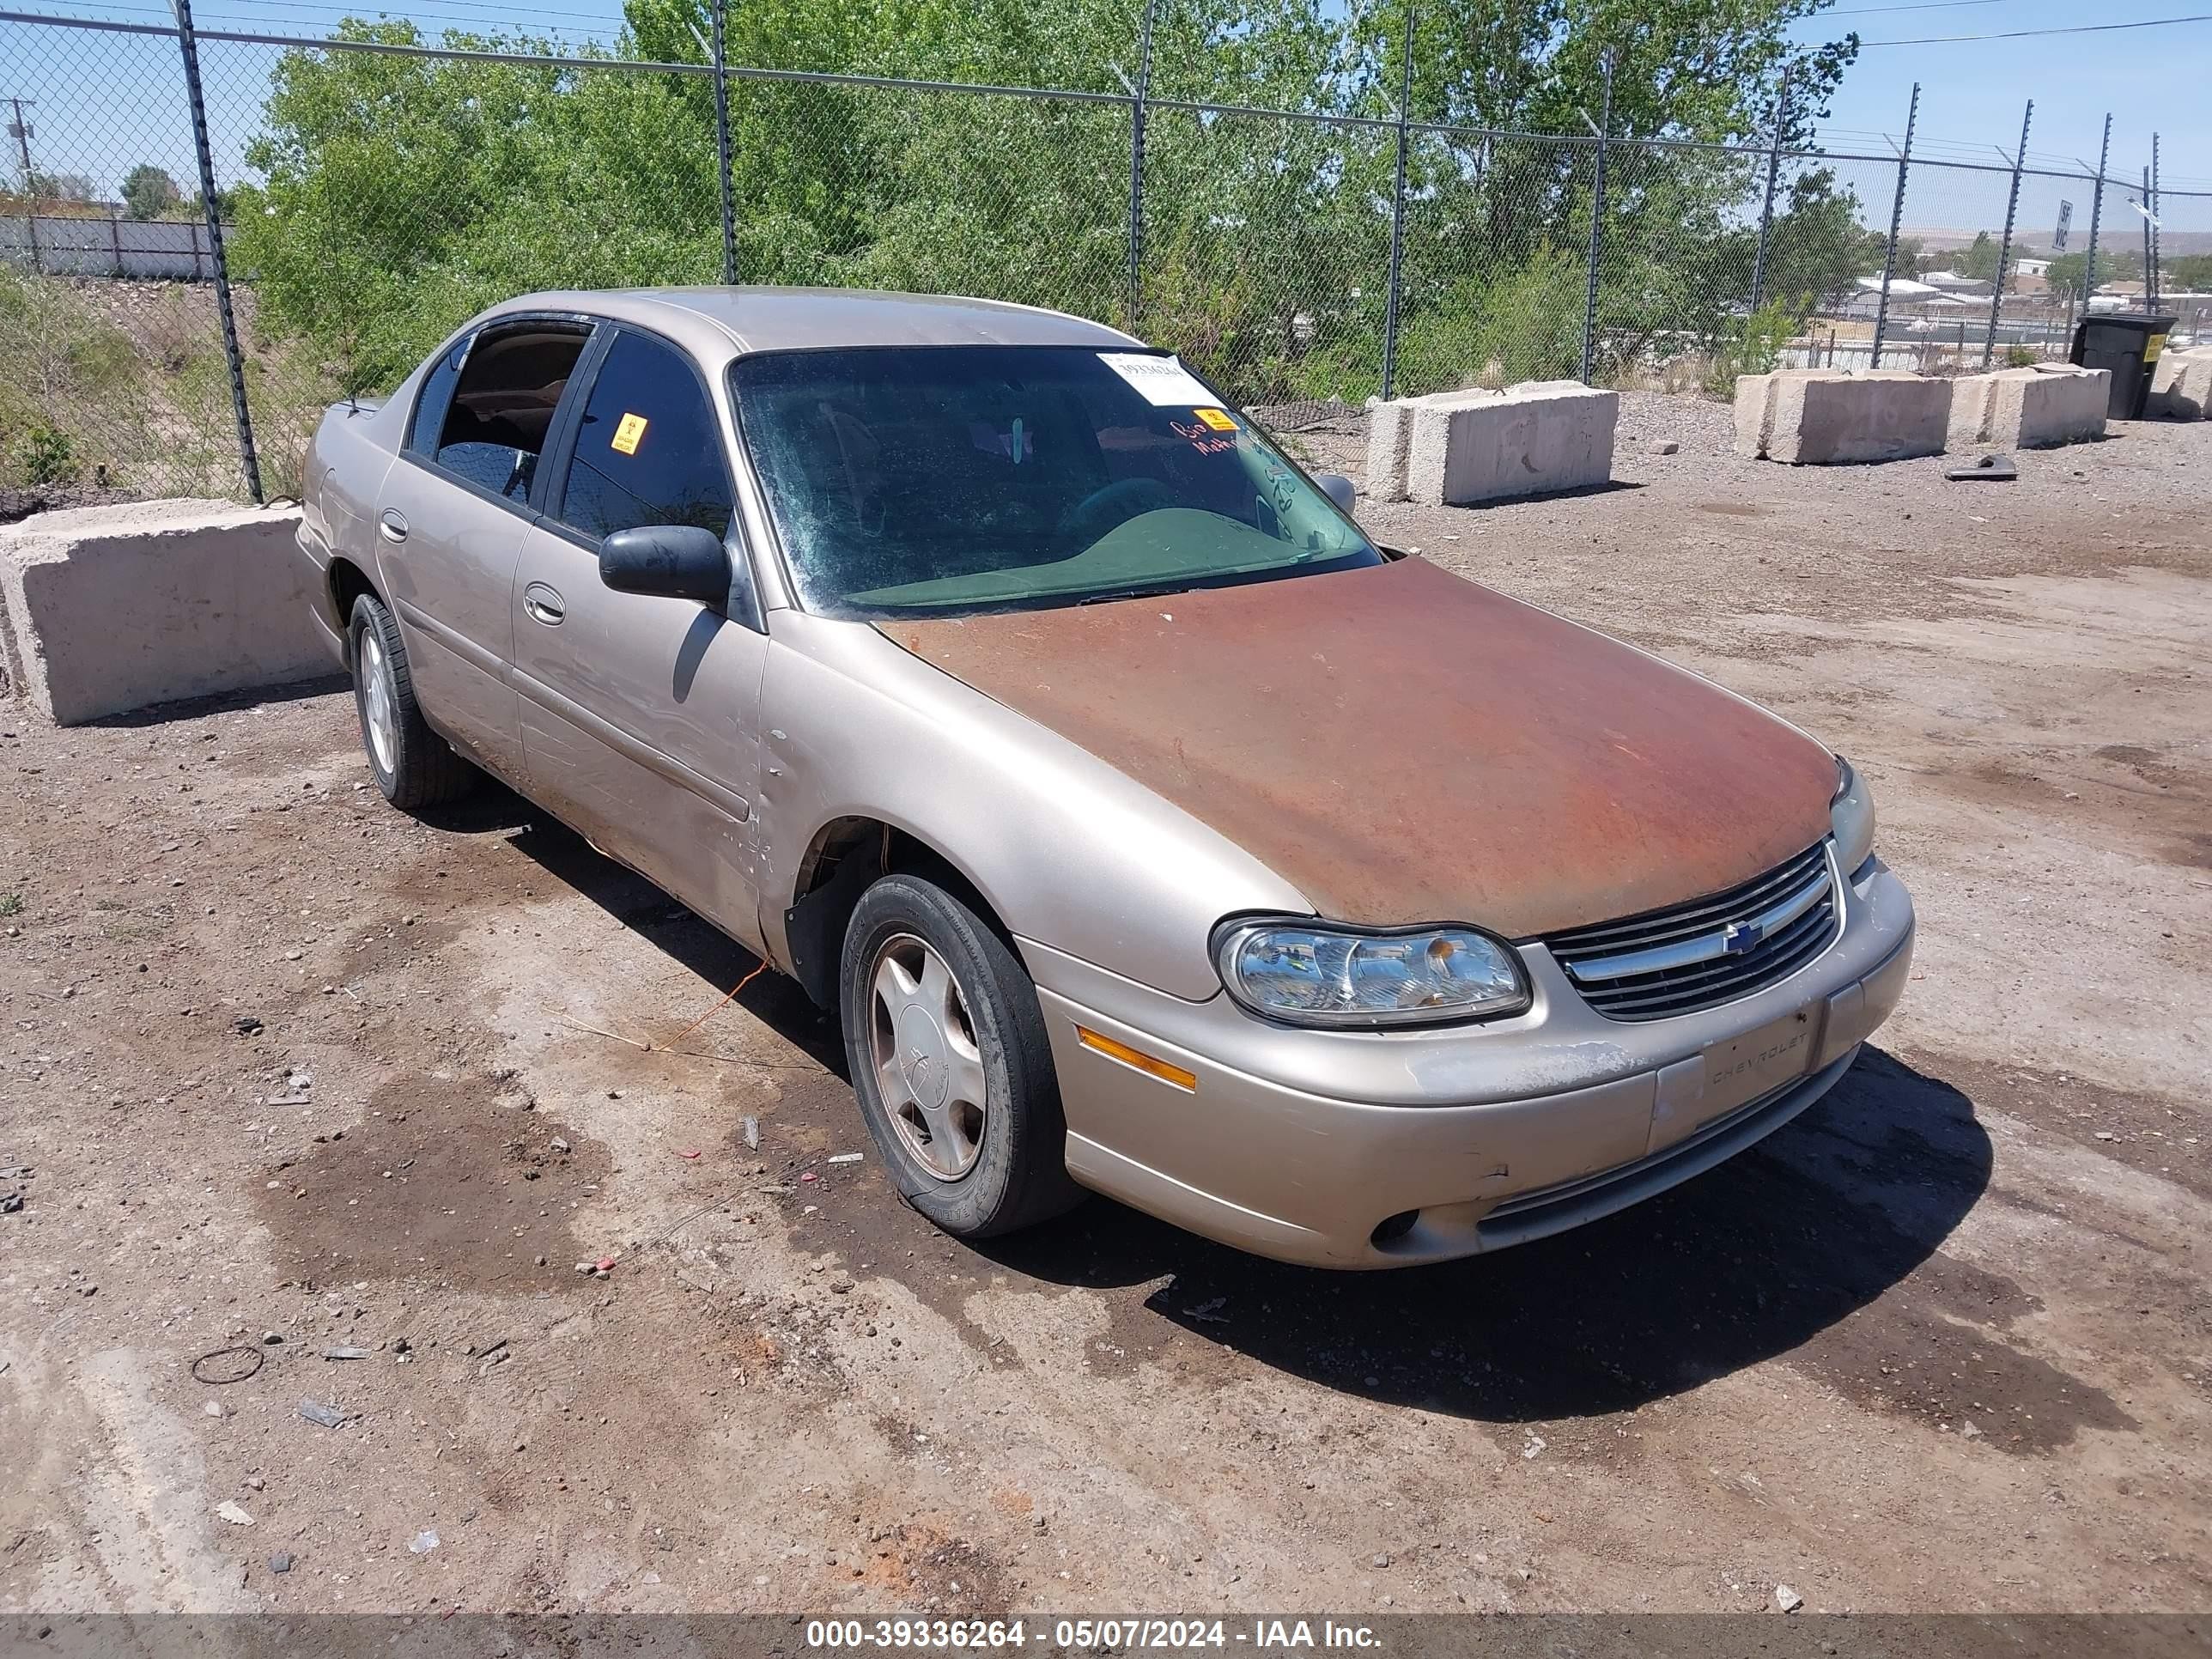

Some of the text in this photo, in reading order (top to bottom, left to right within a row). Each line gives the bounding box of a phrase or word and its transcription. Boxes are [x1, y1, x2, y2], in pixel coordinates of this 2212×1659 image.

[2061, 204, 2071, 223] SF
[2056, 227, 2068, 248] VIC
[1170, 421, 1207, 439] Bio
[1712, 1031, 1808, 1085] CHEVROLET
